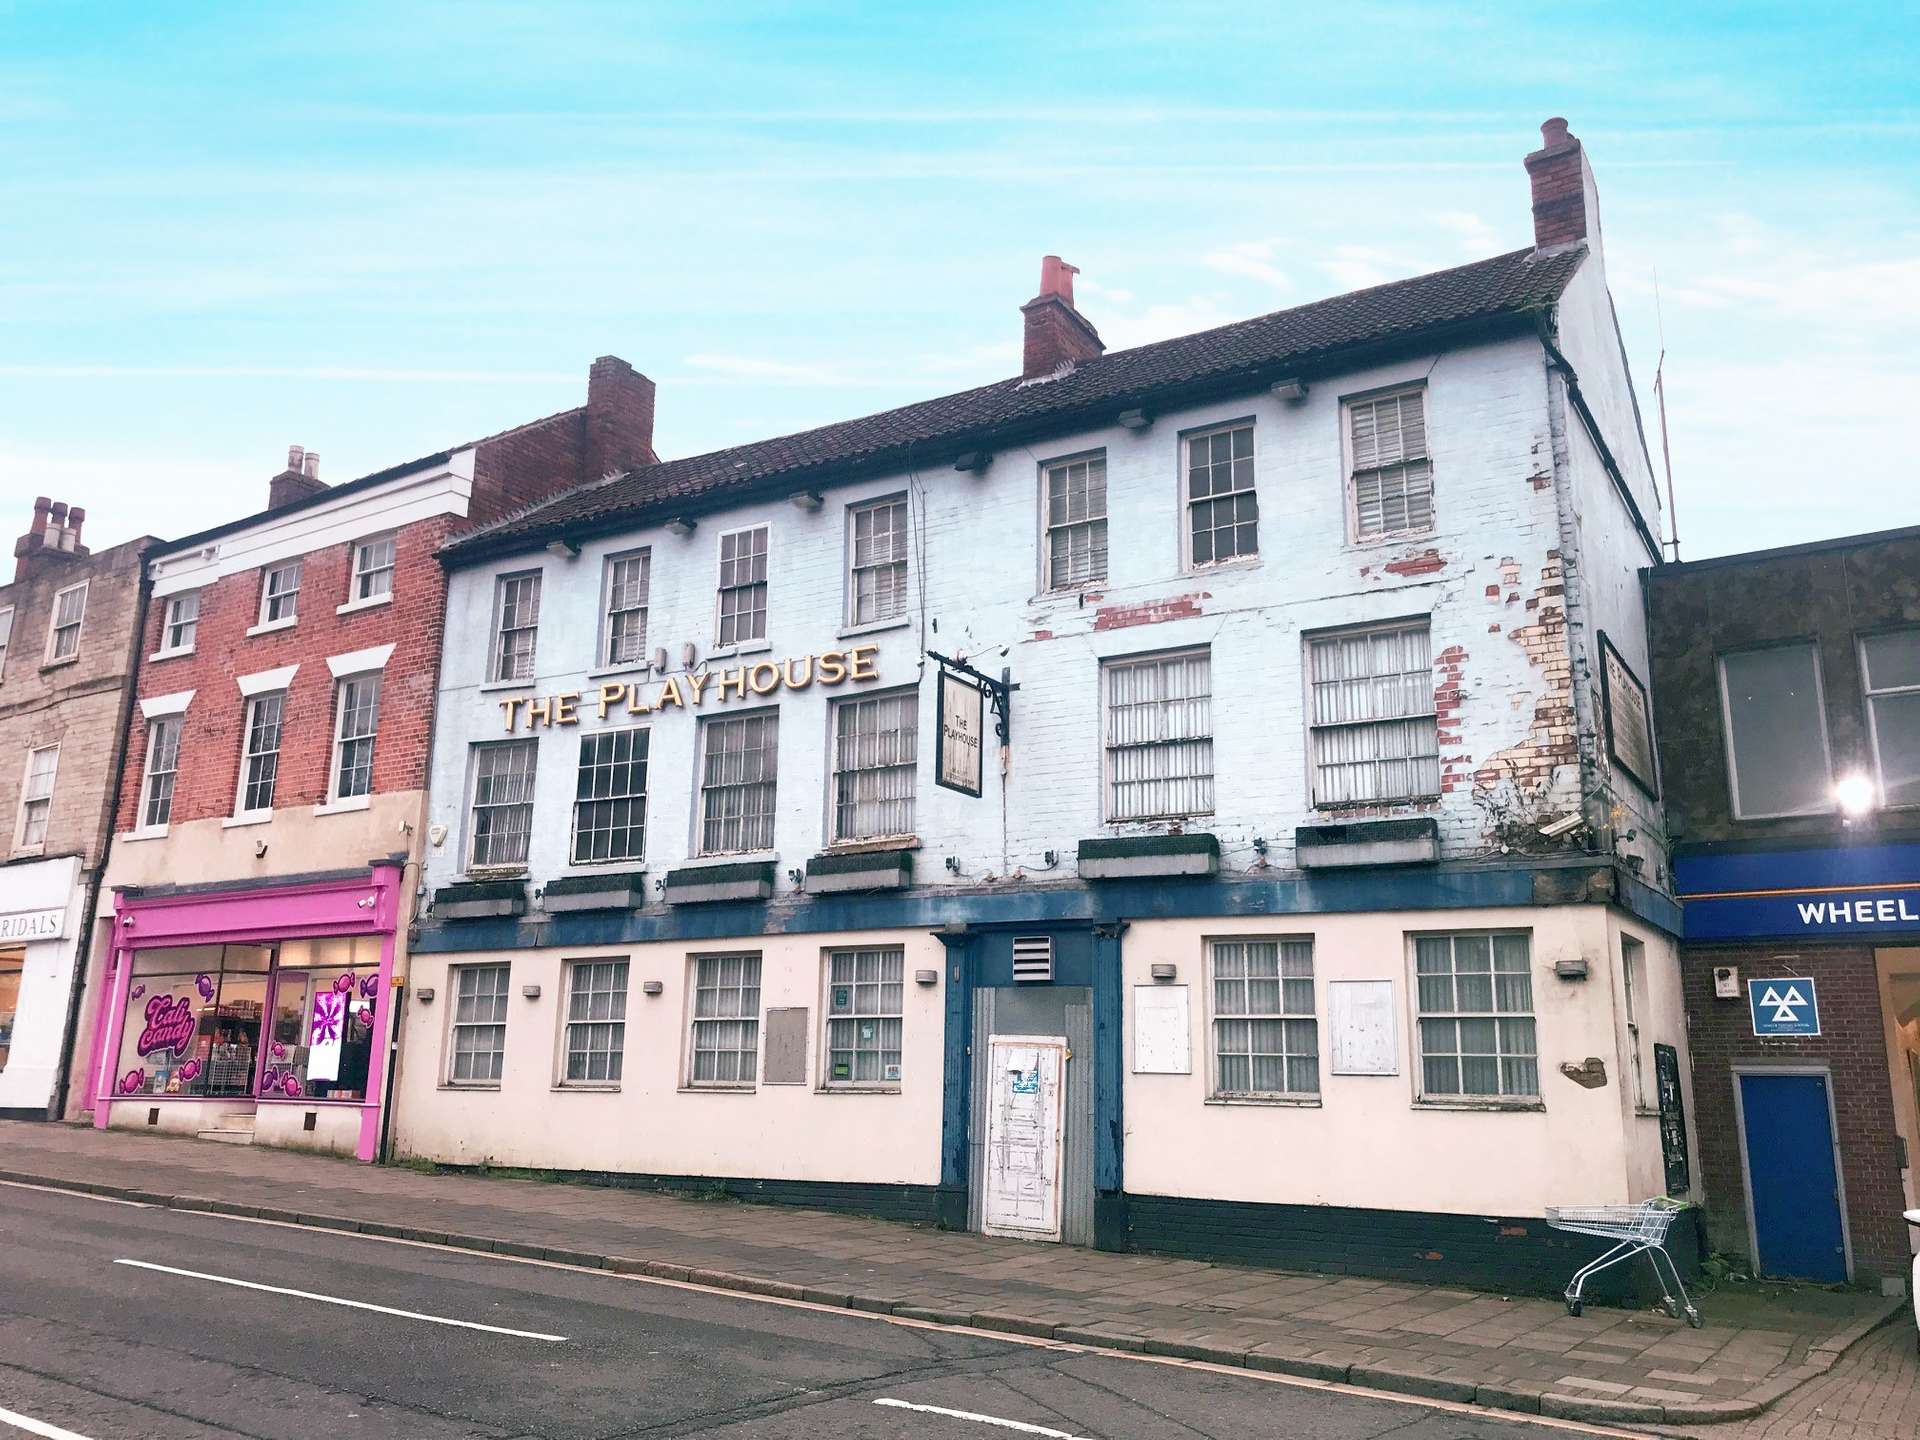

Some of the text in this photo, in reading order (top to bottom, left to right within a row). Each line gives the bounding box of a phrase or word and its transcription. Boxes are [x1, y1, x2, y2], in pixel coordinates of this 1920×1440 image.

[499, 643, 880, 732] THE PLAYHOUSE
[955, 714, 968, 730] THE
[943, 723, 979, 748] PLAYHOUSE
[1796, 898, 1920, 925] WHEEL
